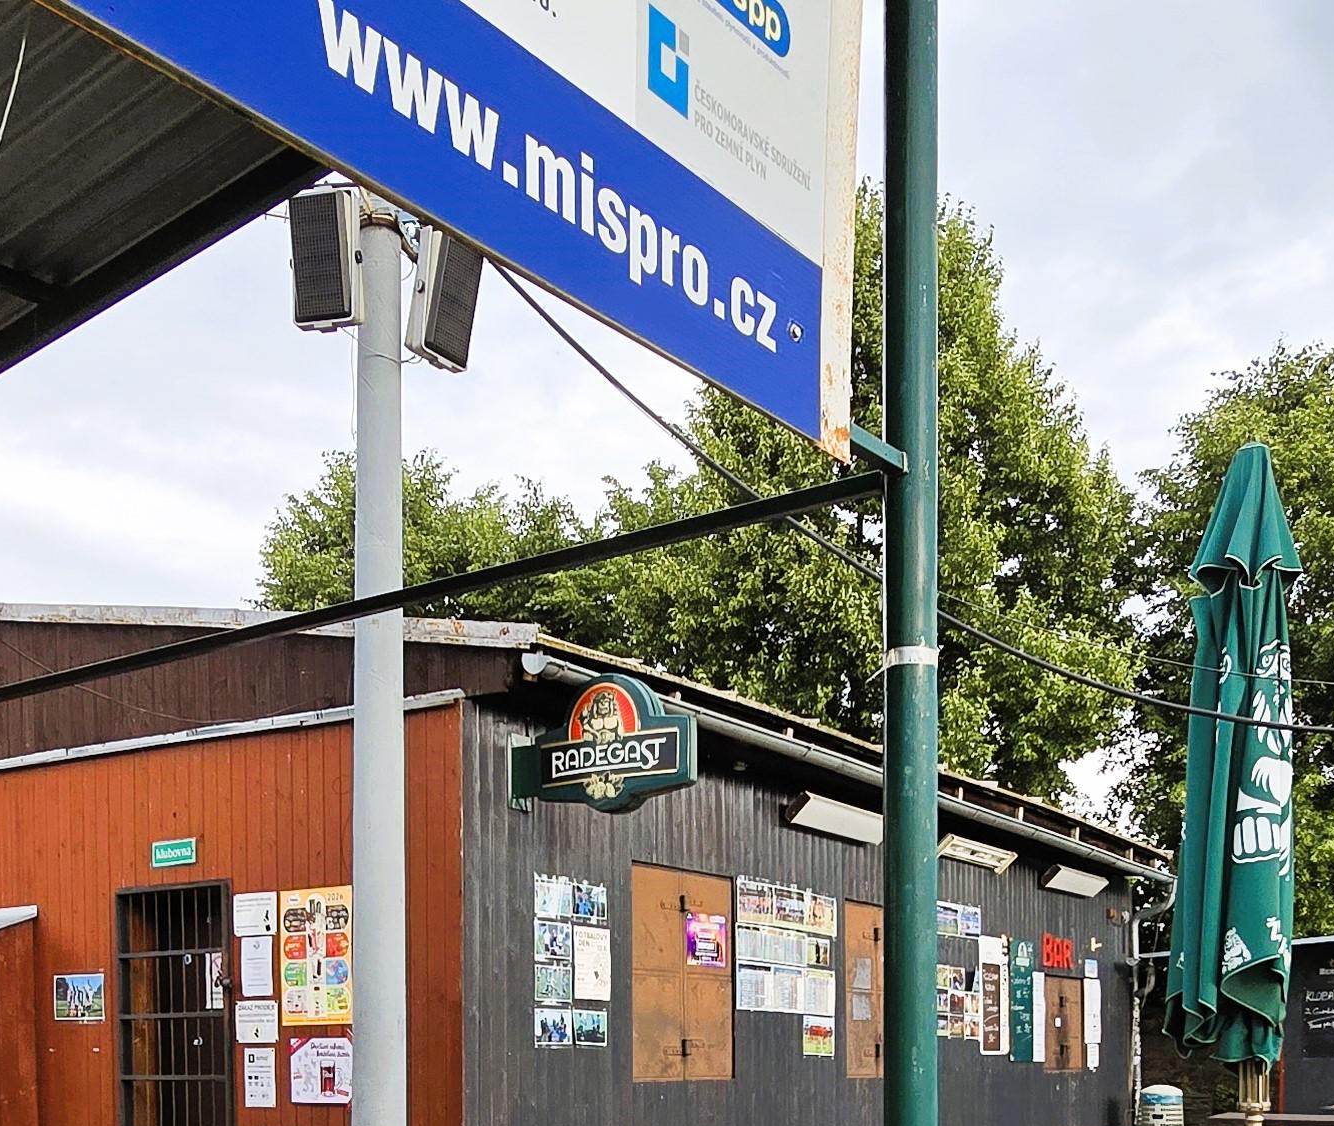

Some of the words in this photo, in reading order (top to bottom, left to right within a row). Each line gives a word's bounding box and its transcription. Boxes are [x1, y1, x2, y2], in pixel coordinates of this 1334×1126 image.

[694, 79, 770, 158] ČESKOMORAVSKÉ
[770, 145, 811, 191] SDRUŽENÍ
[694, 109, 713, 139] PRO
[714, 126, 744, 162] ZEMNÍ
[745, 150, 767, 181] PLYN
[319, 0, 777, 353] www.mispro.cz
[552, 736, 667, 779] RADEGAST
[1042, 931, 1073, 970] BAR
